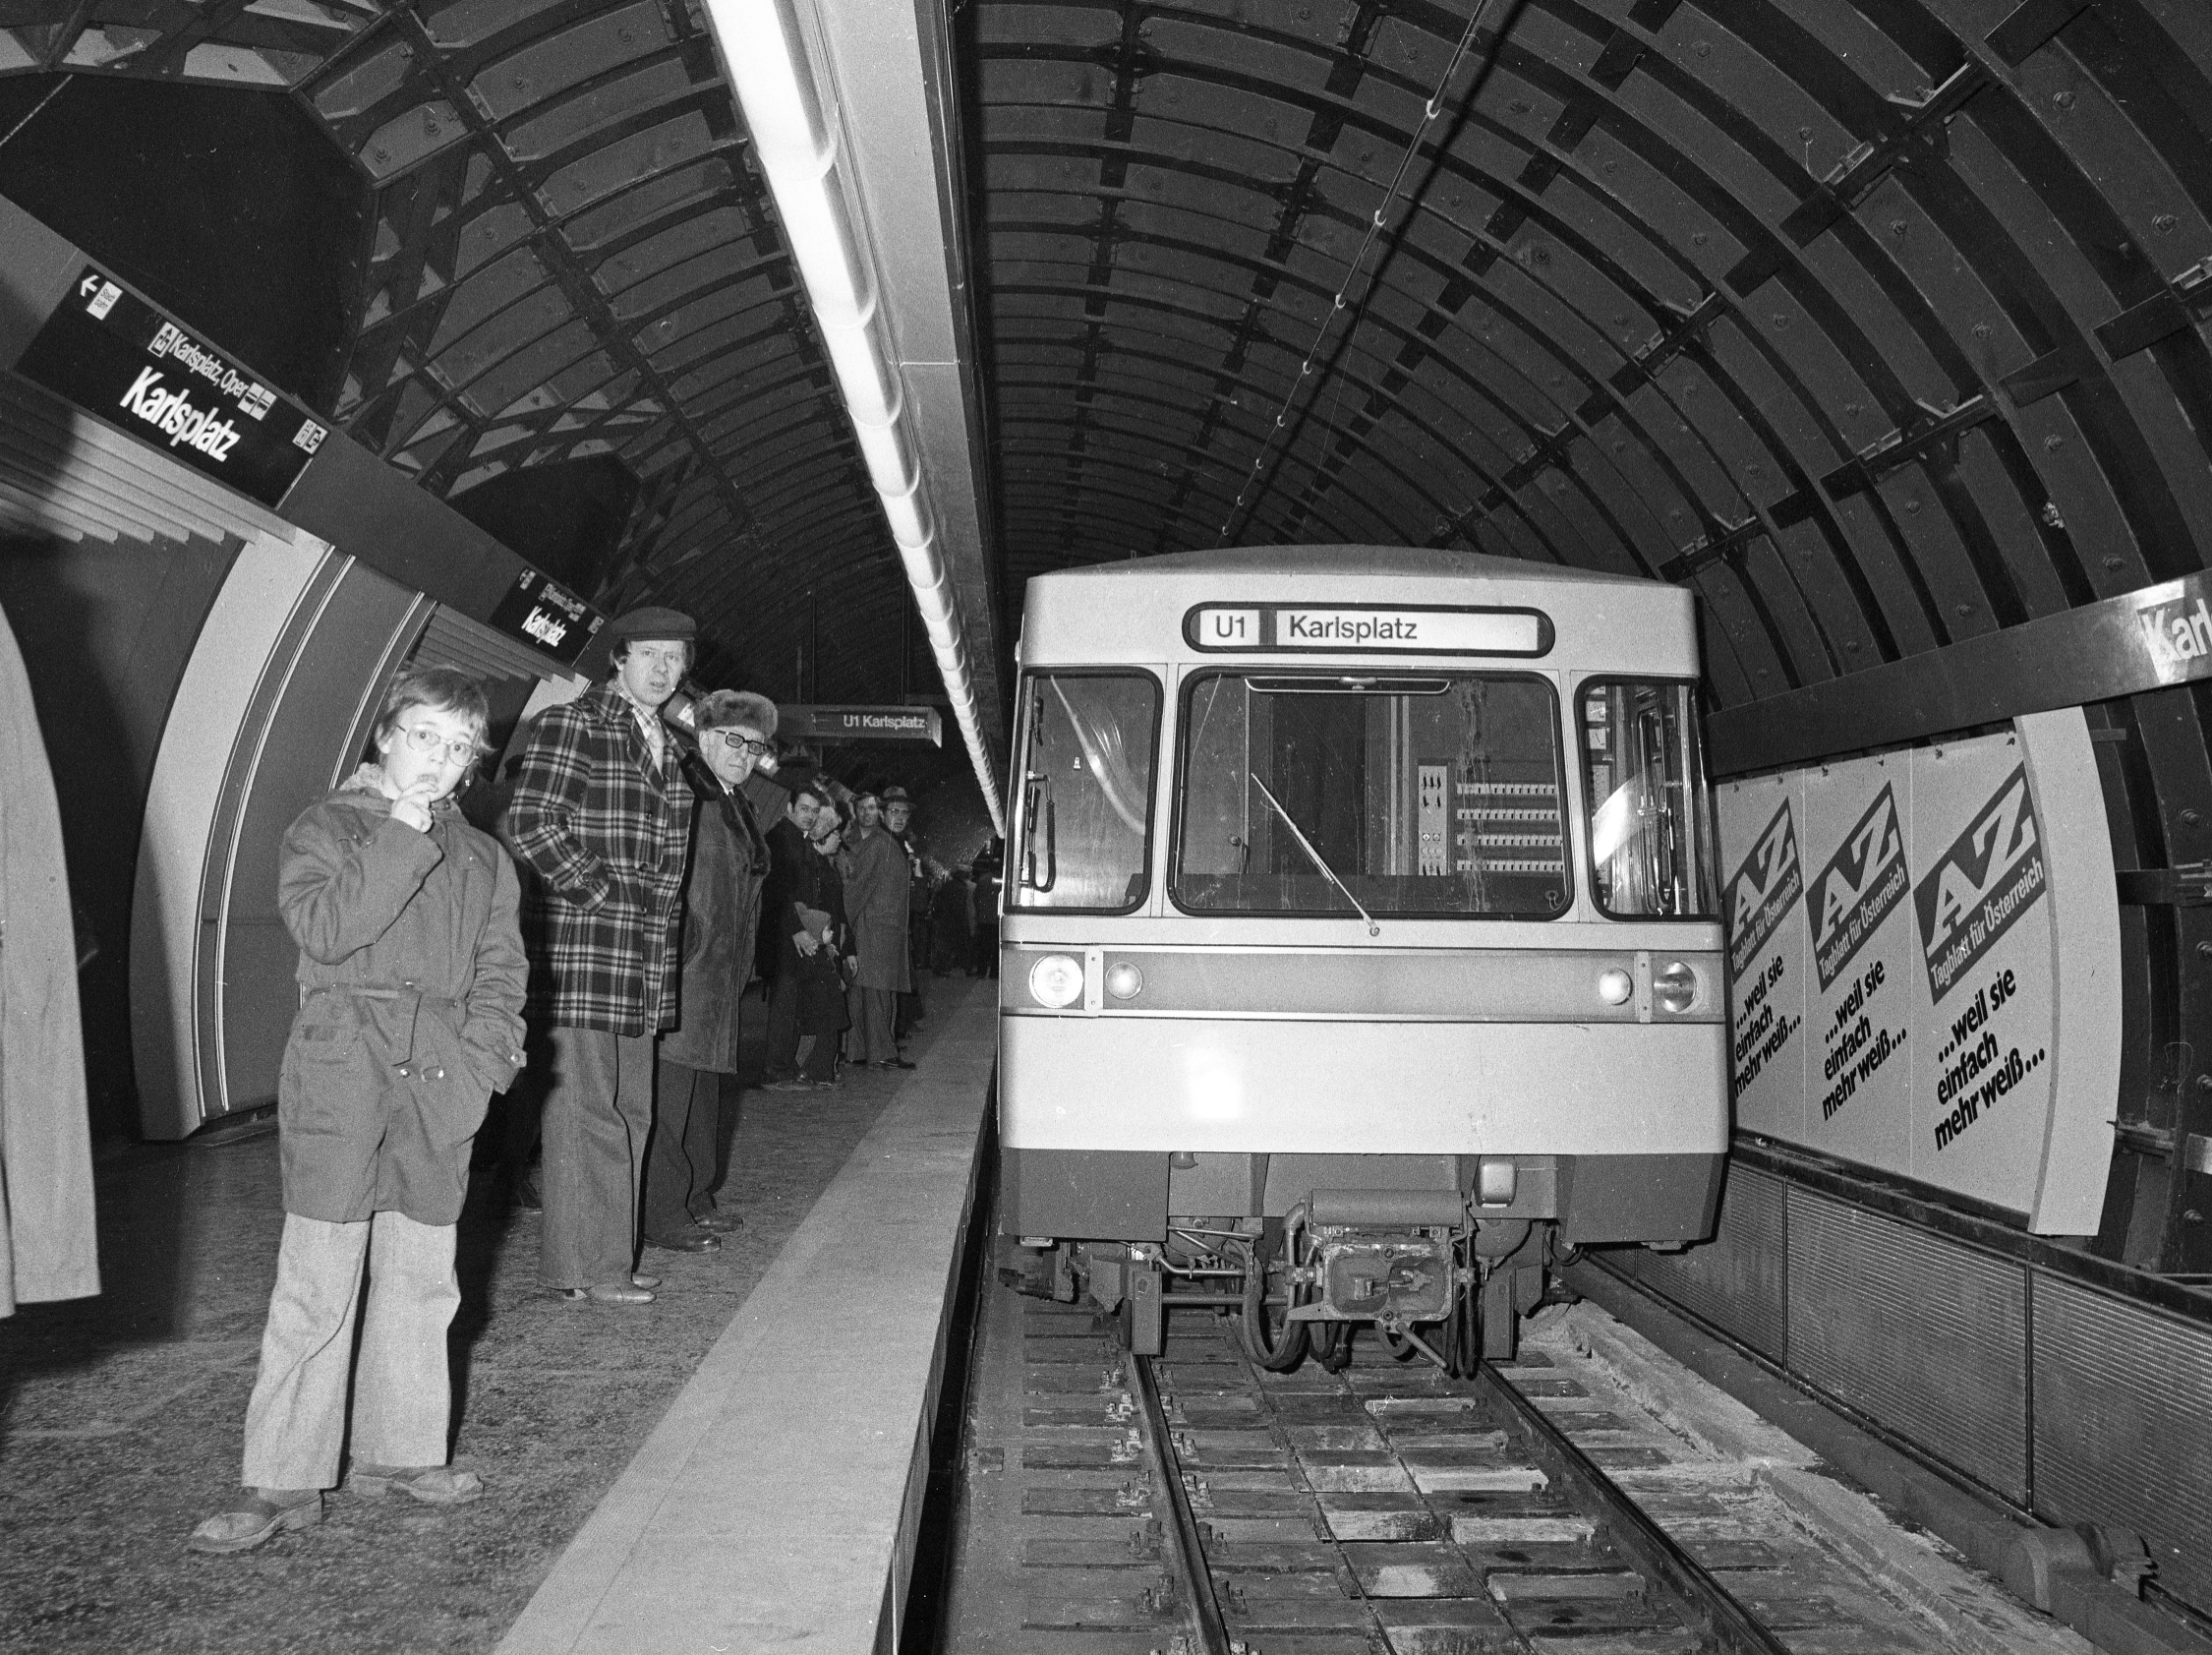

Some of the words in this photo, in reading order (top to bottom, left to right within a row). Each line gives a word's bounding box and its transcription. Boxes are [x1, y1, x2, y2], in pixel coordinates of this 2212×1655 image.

[169, 333, 224, 386] Karlsplatz,
[220, 369, 249, 397] Oper
[119, 365, 241, 462] Karlsplatz
[1215, 615, 1246, 639] U1
[1289, 614, 1418, 644] Karlsplatz
[2141, 597, 2212, 662] Karl
[843, 714, 859, 728] U1
[862, 714, 926, 731] Karlsplatz
[1730, 809, 1796, 947] AZ
[1816, 795, 1901, 953] AZ
[1926, 776, 2037, 960] AZ
[1731, 922, 1757, 972] Tagblatt
[1763, 869, 1800, 926] Österreich
[1819, 936, 1851, 980] Tagblatt
[1859, 862, 1906, 930] Österreich
[1930, 936, 1971, 991] Tagblatt
[1968, 916, 1987, 951] für
[1983, 855, 2045, 933] Österreich
[1735, 970, 1768, 1031] ...weil
[1767, 954, 1784, 988] sie
[1735, 1004, 1774, 1062] einfach
[1825, 978, 1864, 1044] ...weil
[1864, 960, 1886, 997] sie
[1937, 988, 1990, 1064] ...weil
[1989, 968, 2017, 1014] sie
[1734, 1046, 1763, 1098] mehr
[1761, 1013, 1802, 1066] weiß...
[1822, 1067, 1858, 1122] mehr
[1856, 1027, 1907, 1083] weiß...
[1824, 1013, 1872, 1082] einfach
[1936, 1030, 2000, 1106] einfach
[1933, 1092, 1980, 1153] mehr
[1977, 1045, 2046, 1103] weiß...
